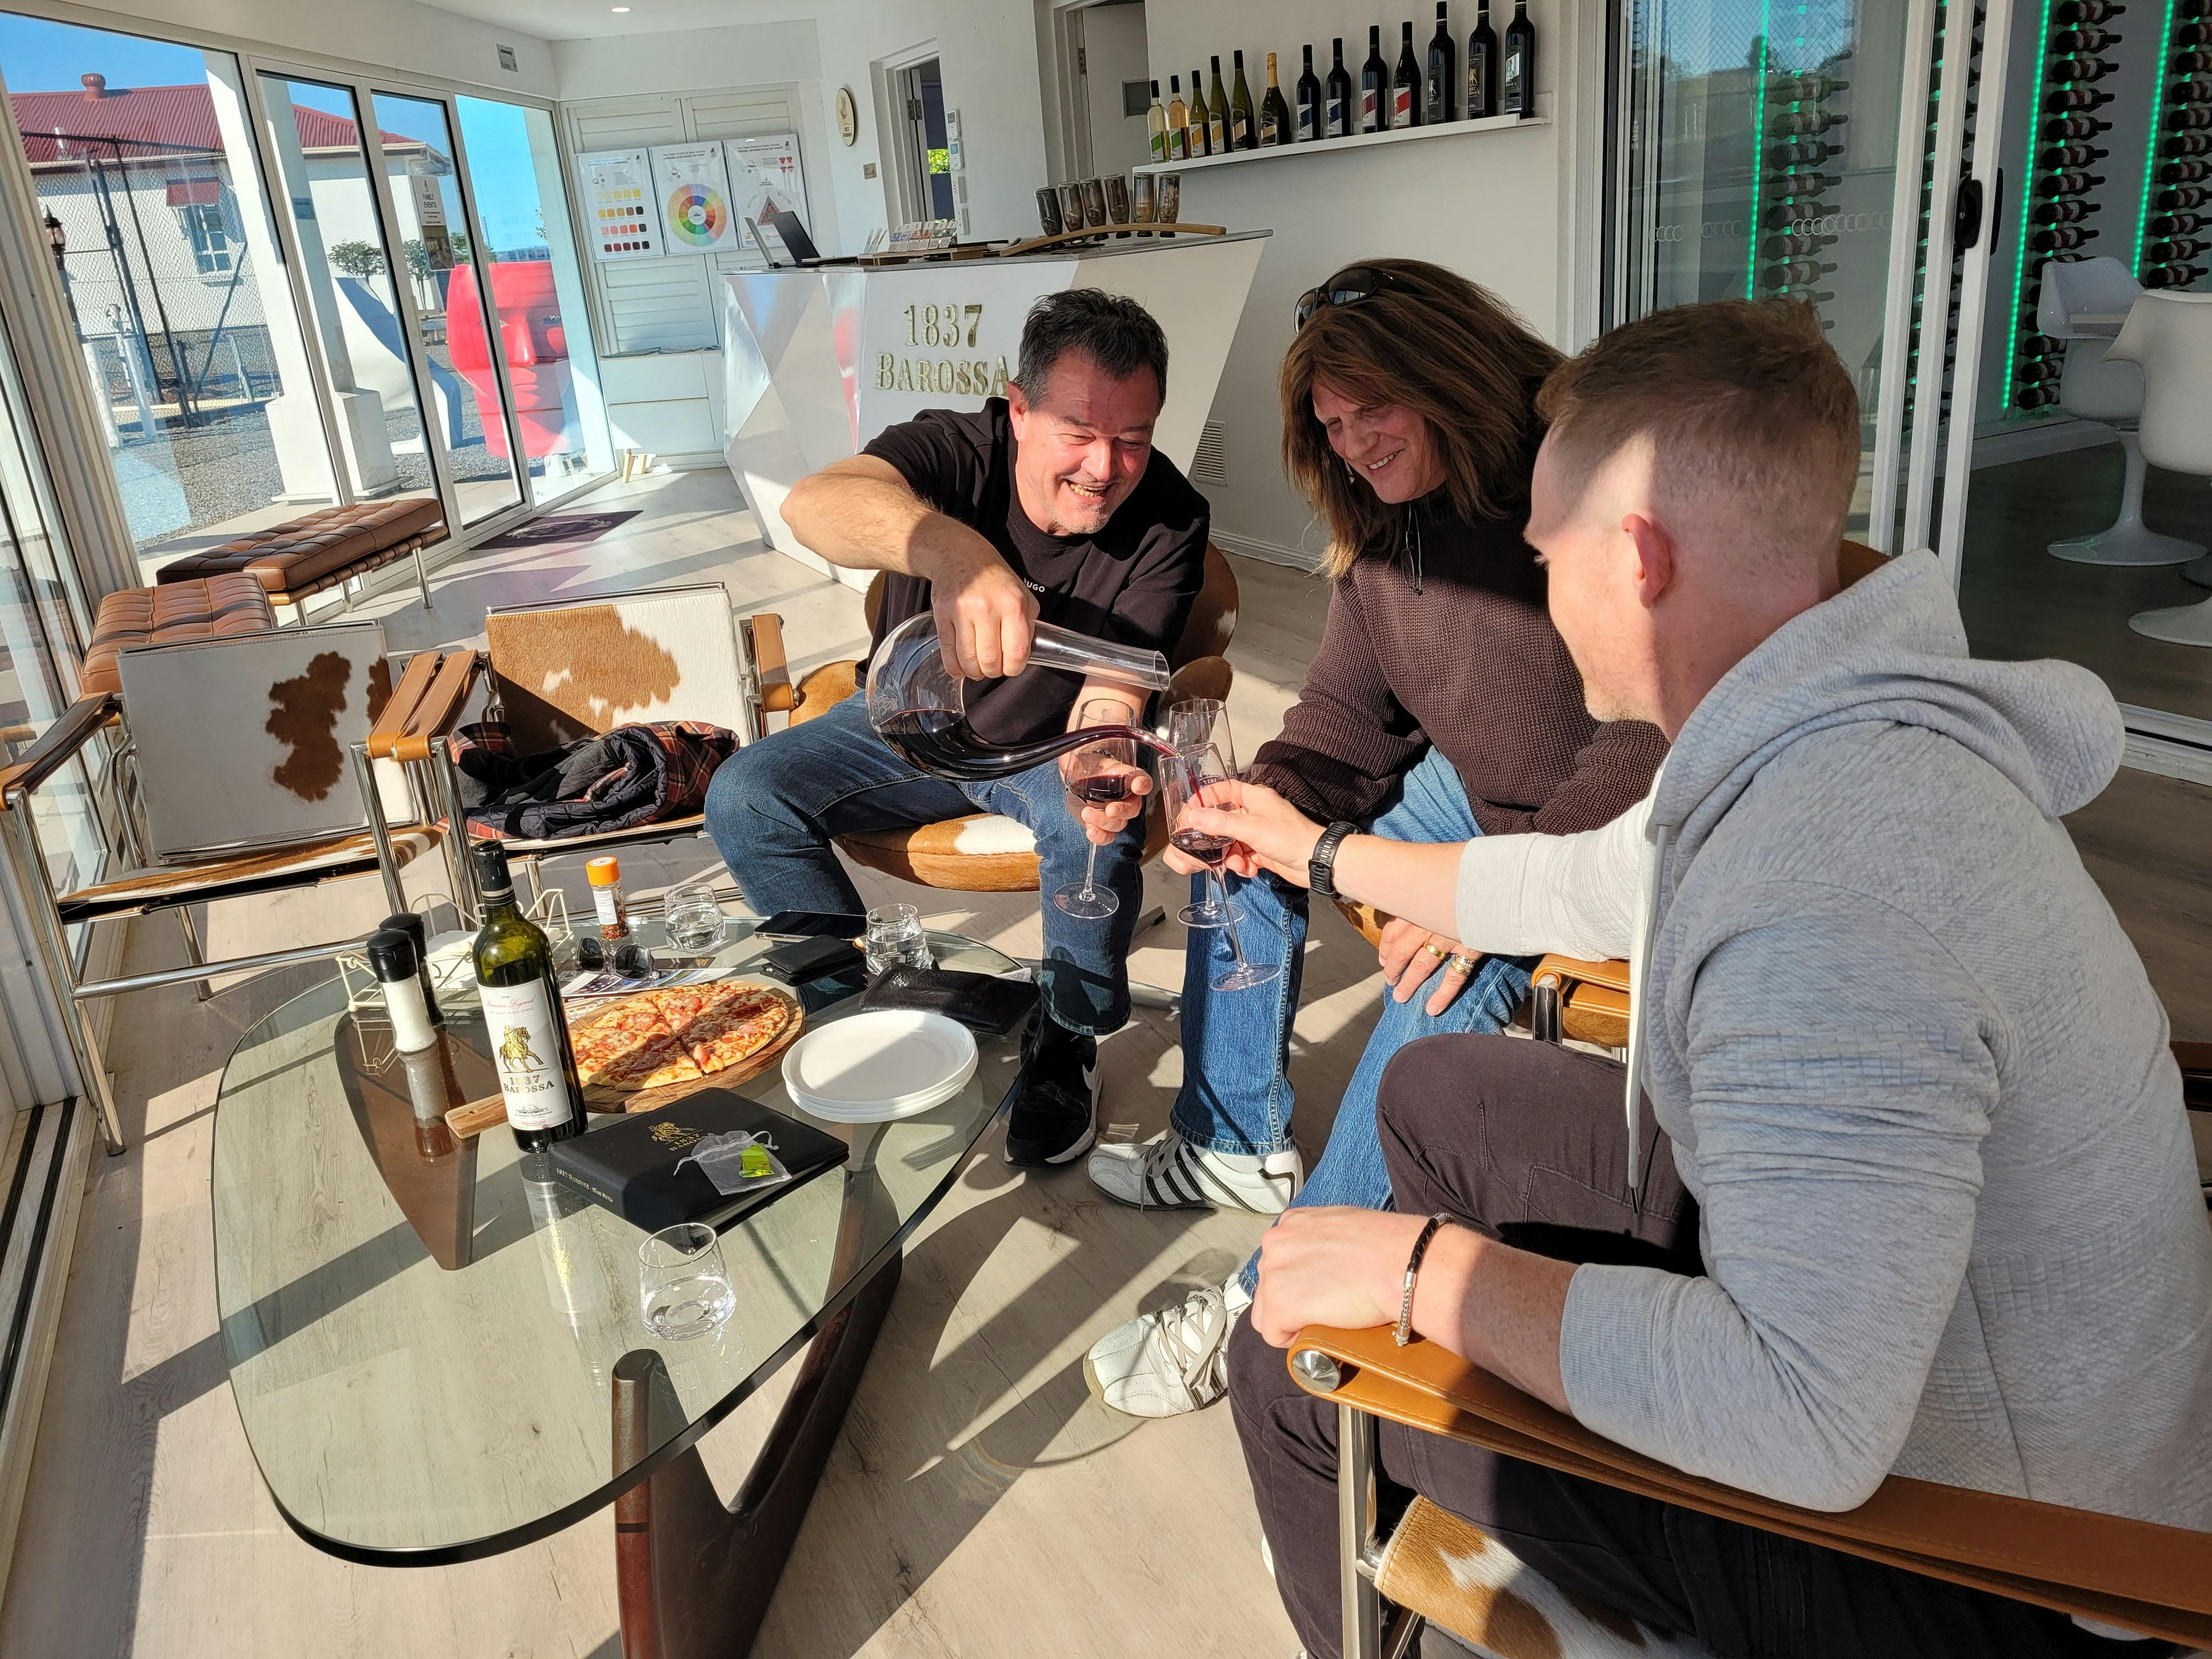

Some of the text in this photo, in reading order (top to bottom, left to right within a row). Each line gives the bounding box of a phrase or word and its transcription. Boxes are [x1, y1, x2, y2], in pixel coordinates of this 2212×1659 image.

[904, 304, 983, 347] 1837
[874, 352, 1008, 396] BAROSSA
[509, 995, 536, 1009] Legend
[504, 1080, 555, 1093] BAROSSA
[510, 1074, 540, 1086] 1837
[668, 1136, 708, 1151] BAROSS
